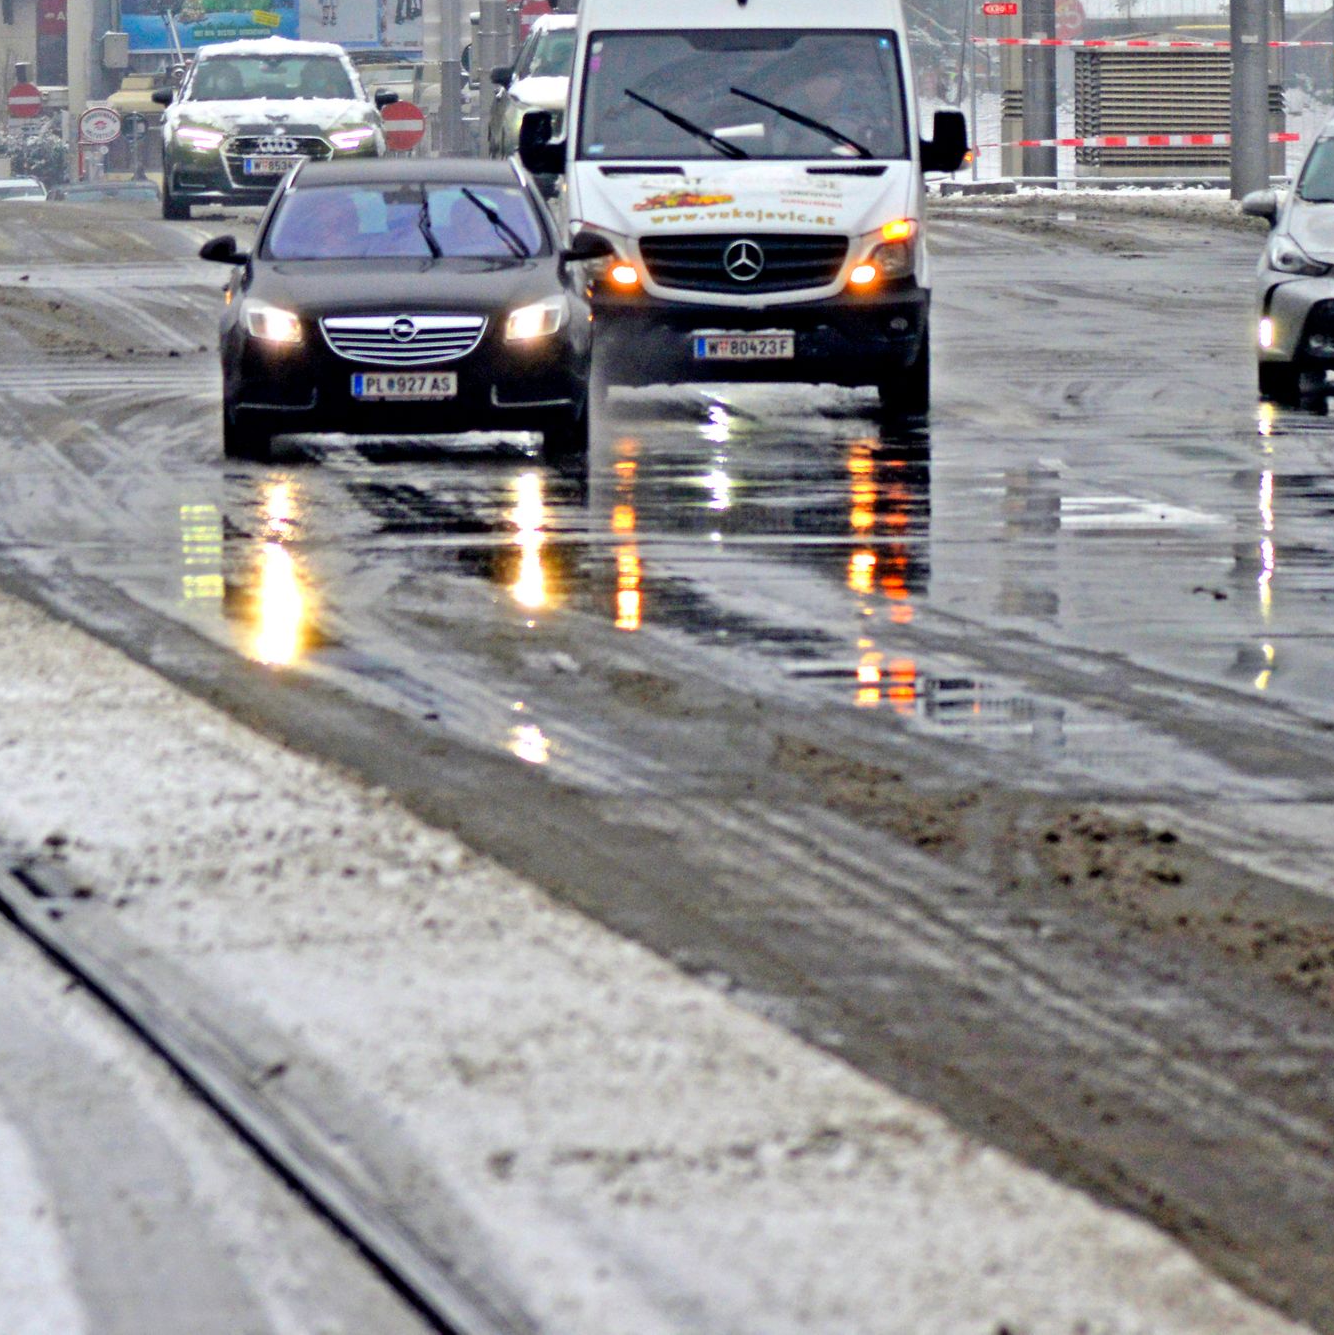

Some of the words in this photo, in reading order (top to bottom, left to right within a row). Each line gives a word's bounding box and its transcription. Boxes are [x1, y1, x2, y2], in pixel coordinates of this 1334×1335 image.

[708, 341, 718, 355] W
[367, 377, 383, 393] PL
[397, 376, 426, 393] 927
[431, 376, 451, 392] AS
